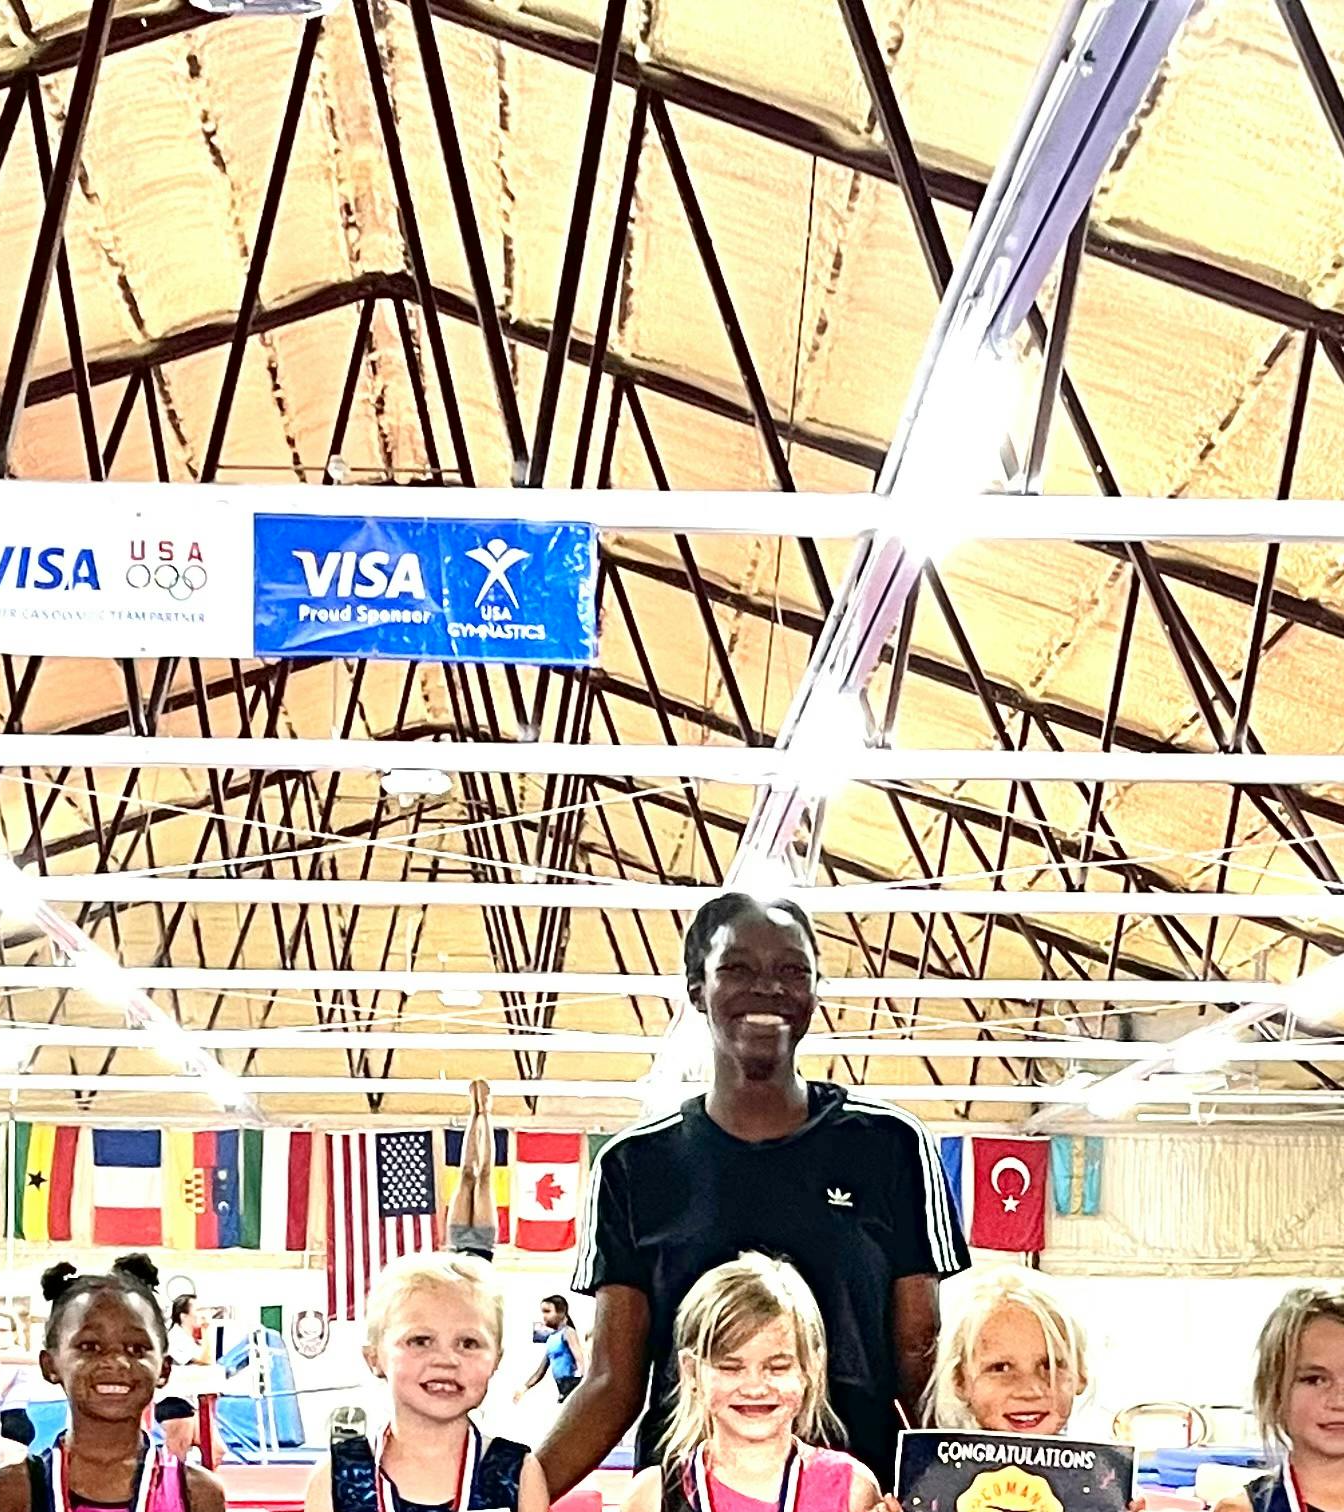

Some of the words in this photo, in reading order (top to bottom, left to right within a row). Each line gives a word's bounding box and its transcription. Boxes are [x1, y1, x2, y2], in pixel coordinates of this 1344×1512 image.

[130, 540, 204, 562] USA
[291, 550, 427, 600] VISA
[298, 604, 352, 623] Proud
[356, 605, 432, 625] Sponsor
[480, 605, 513, 622] USA
[446, 622, 546, 641] GYMNASTICS
[937, 1441, 1096, 1469] CONGRATULATIONS
